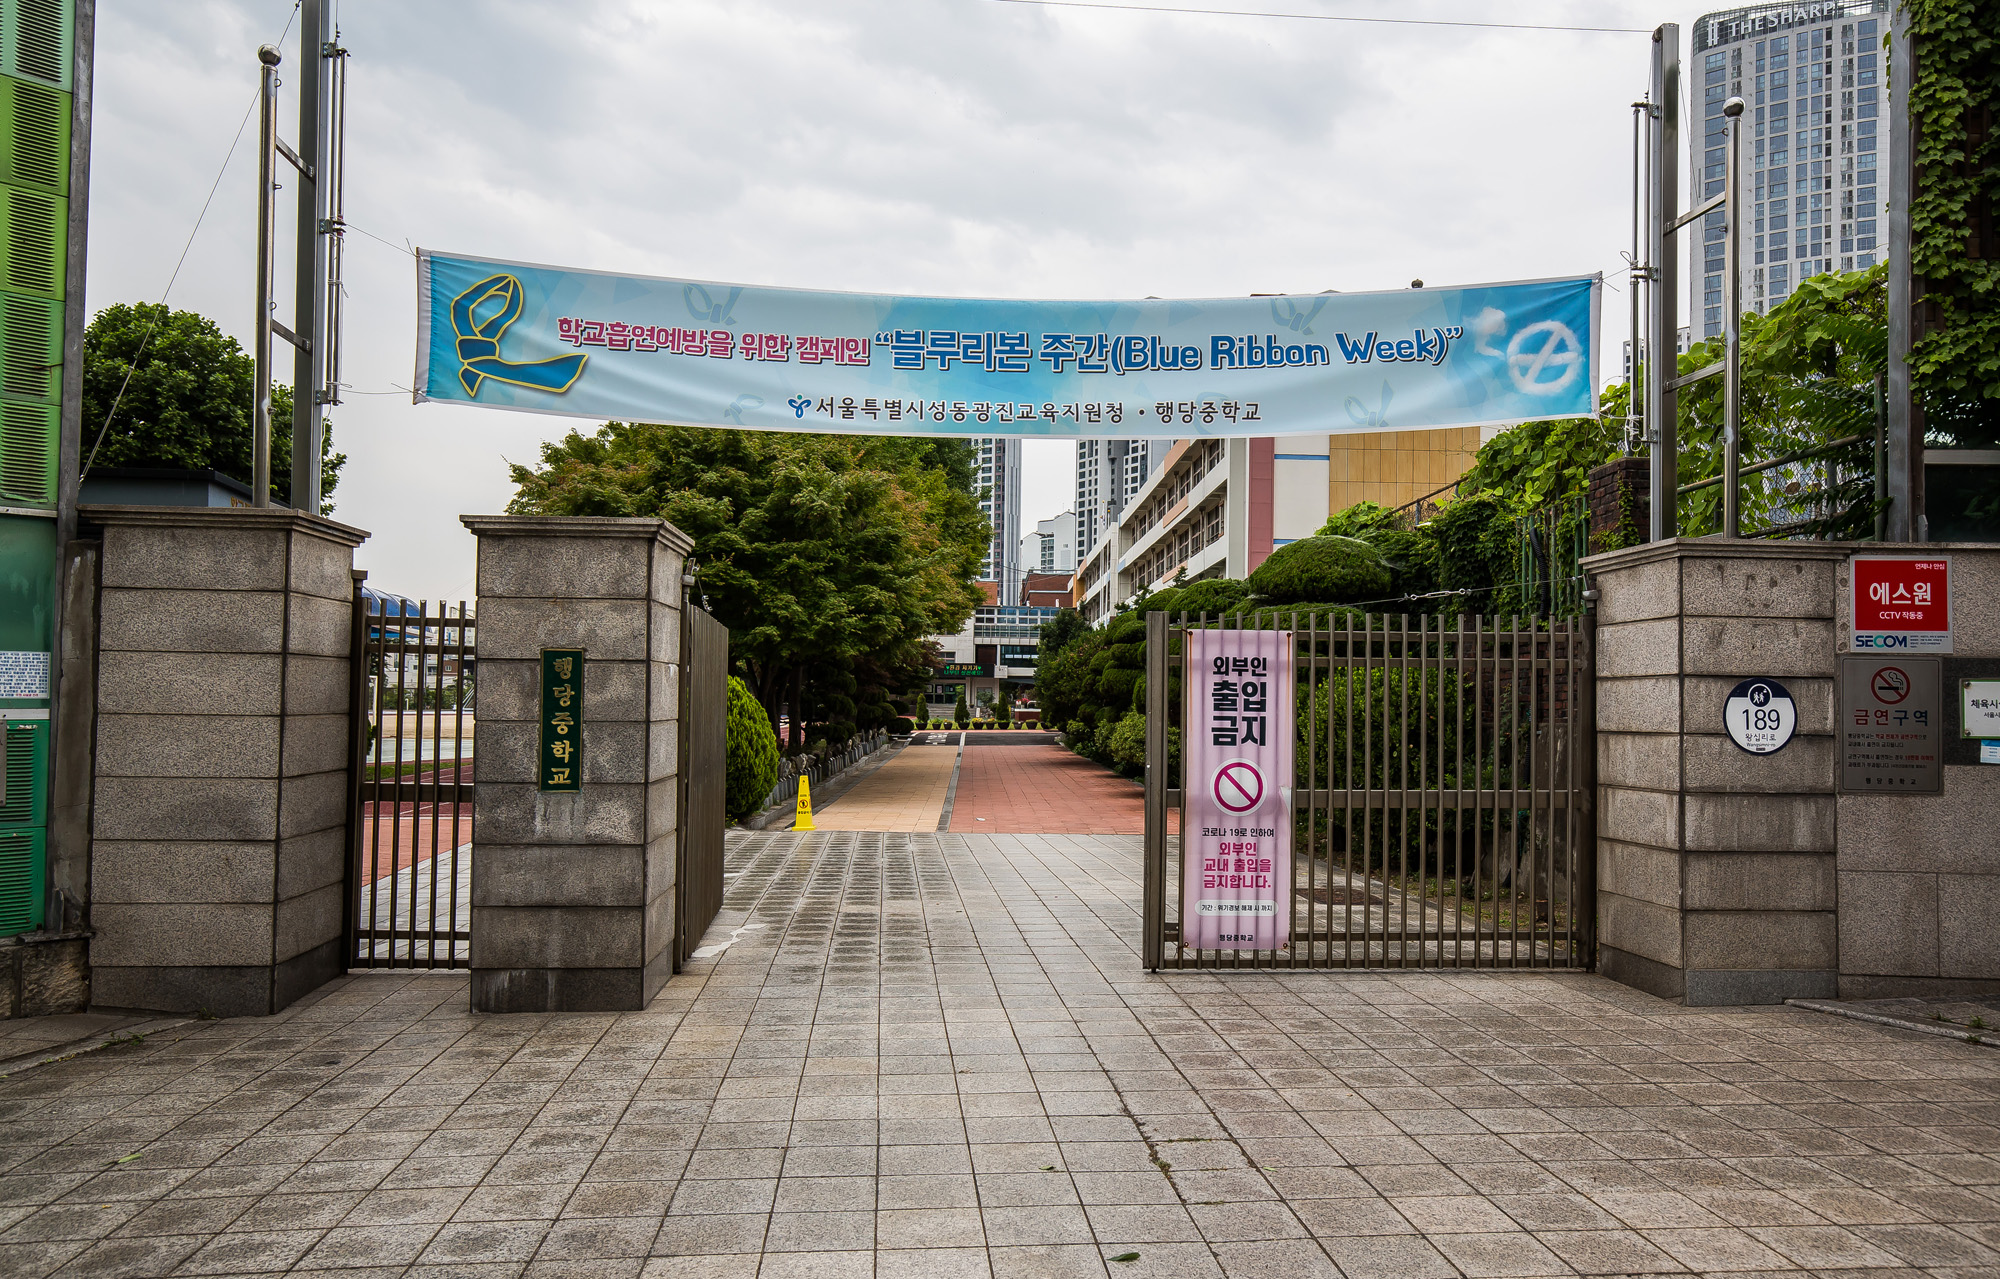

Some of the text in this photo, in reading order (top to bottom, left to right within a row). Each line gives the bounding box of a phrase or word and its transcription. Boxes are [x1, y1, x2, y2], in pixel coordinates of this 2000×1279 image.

[557, 316, 735, 360] 학교흡연예방을
[739, 331, 790, 362] 위한
[795, 335, 871, 367] 캠페인
[1210, 333, 1330, 371] Ribbon
[816, 396, 1123, 423] 서울특별시성동광진교육지원청
[1155, 400, 1261, 424] 행당중학교
[1869, 582, 1931, 605] 에스원
[1879, 611, 1923, 620] CCTV 작동중
[1855, 634, 1908, 648] SECOM
[1212, 656, 1267, 677] 외부인
[1212, 680, 1267, 712] 출입
[1970, 699, 2000, 709] 체육시
[547, 656, 575, 785] 행당중학교
[1742, 709, 1780, 730] 189
[1854, 709, 1928, 727] 금연구역
[1211, 715, 1267, 746] 금지
[1745, 733, 1776, 742] 왕십리로
[1202, 827, 1275, 838] 코로나 19로 인하여
[1219, 842, 1257, 856] 외부인
[1203, 858, 1271, 873] 교내 출입을
[1203, 874, 1271, 889] 금지합니다.
